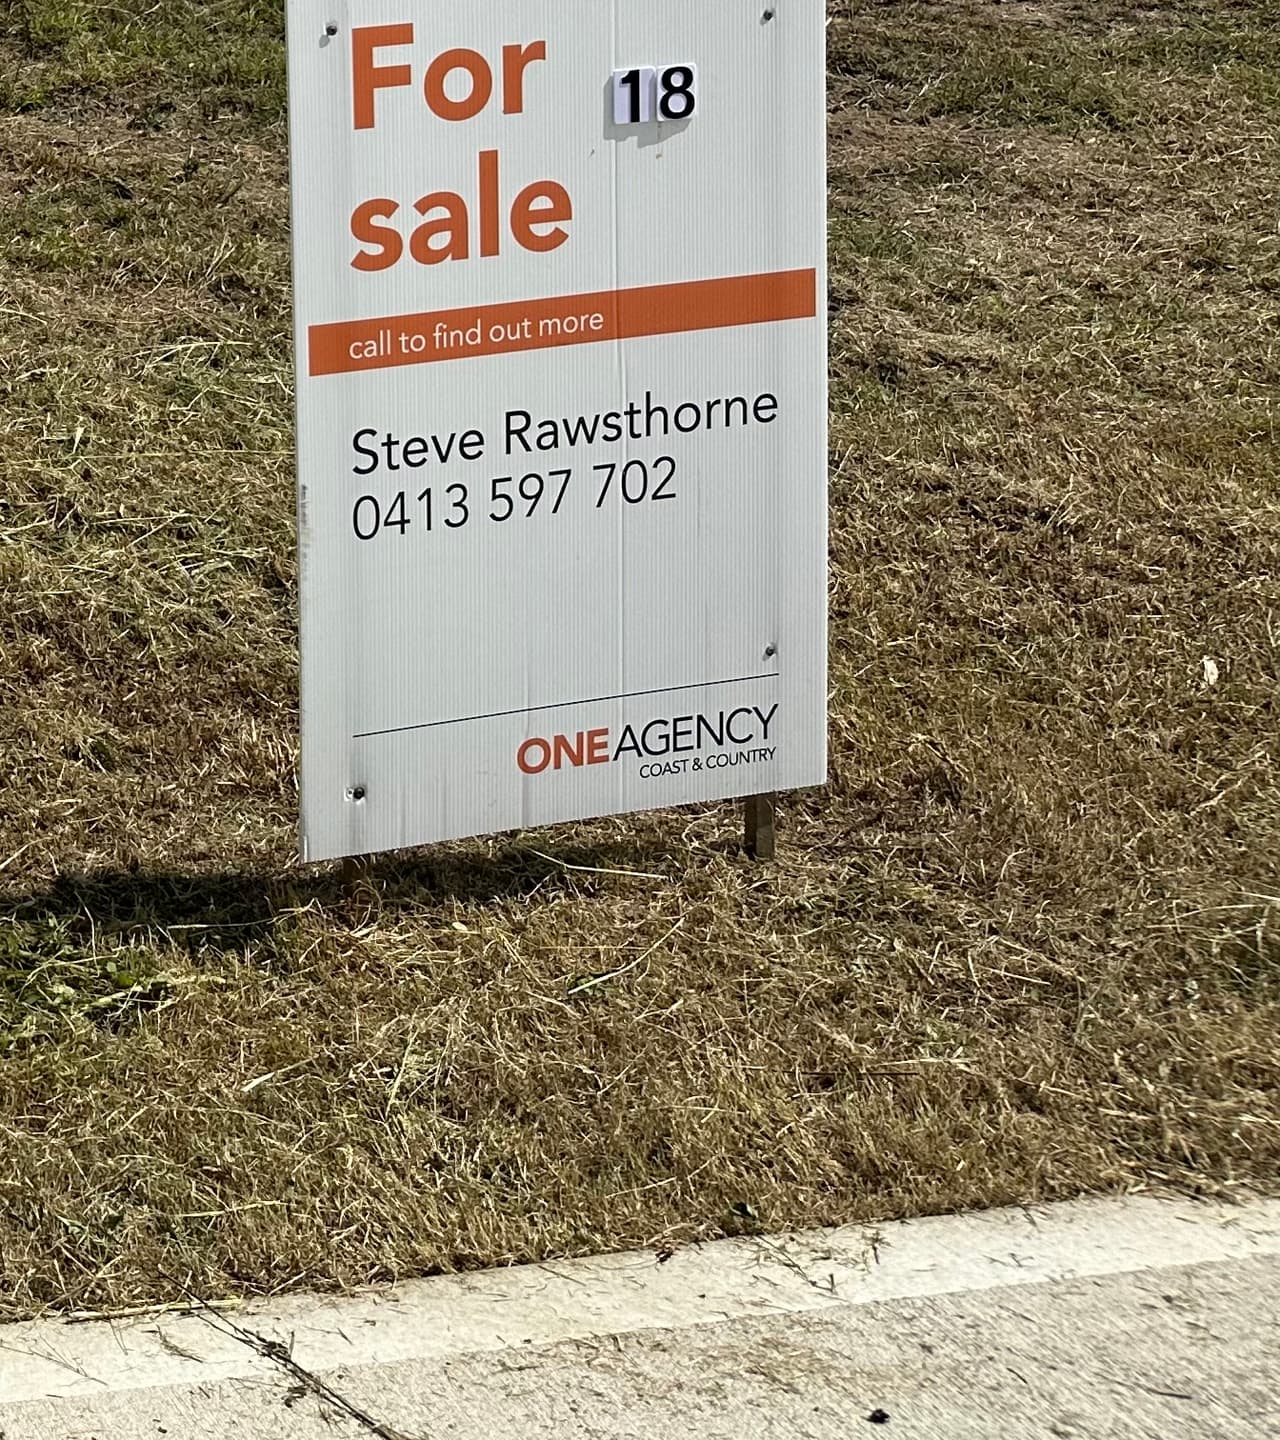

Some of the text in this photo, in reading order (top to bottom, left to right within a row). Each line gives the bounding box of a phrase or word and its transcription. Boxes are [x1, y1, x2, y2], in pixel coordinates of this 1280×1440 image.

[351, 22, 546, 130] For
[619, 65, 696, 123] 18
[349, 149, 573, 272] sale
[348, 310, 605, 360] call to find out more
[351, 390, 779, 475] Steve Rawsthorne
[352, 455, 677, 540] 0413 597 702
[639, 746, 777, 779] COAST & COUNTRY
